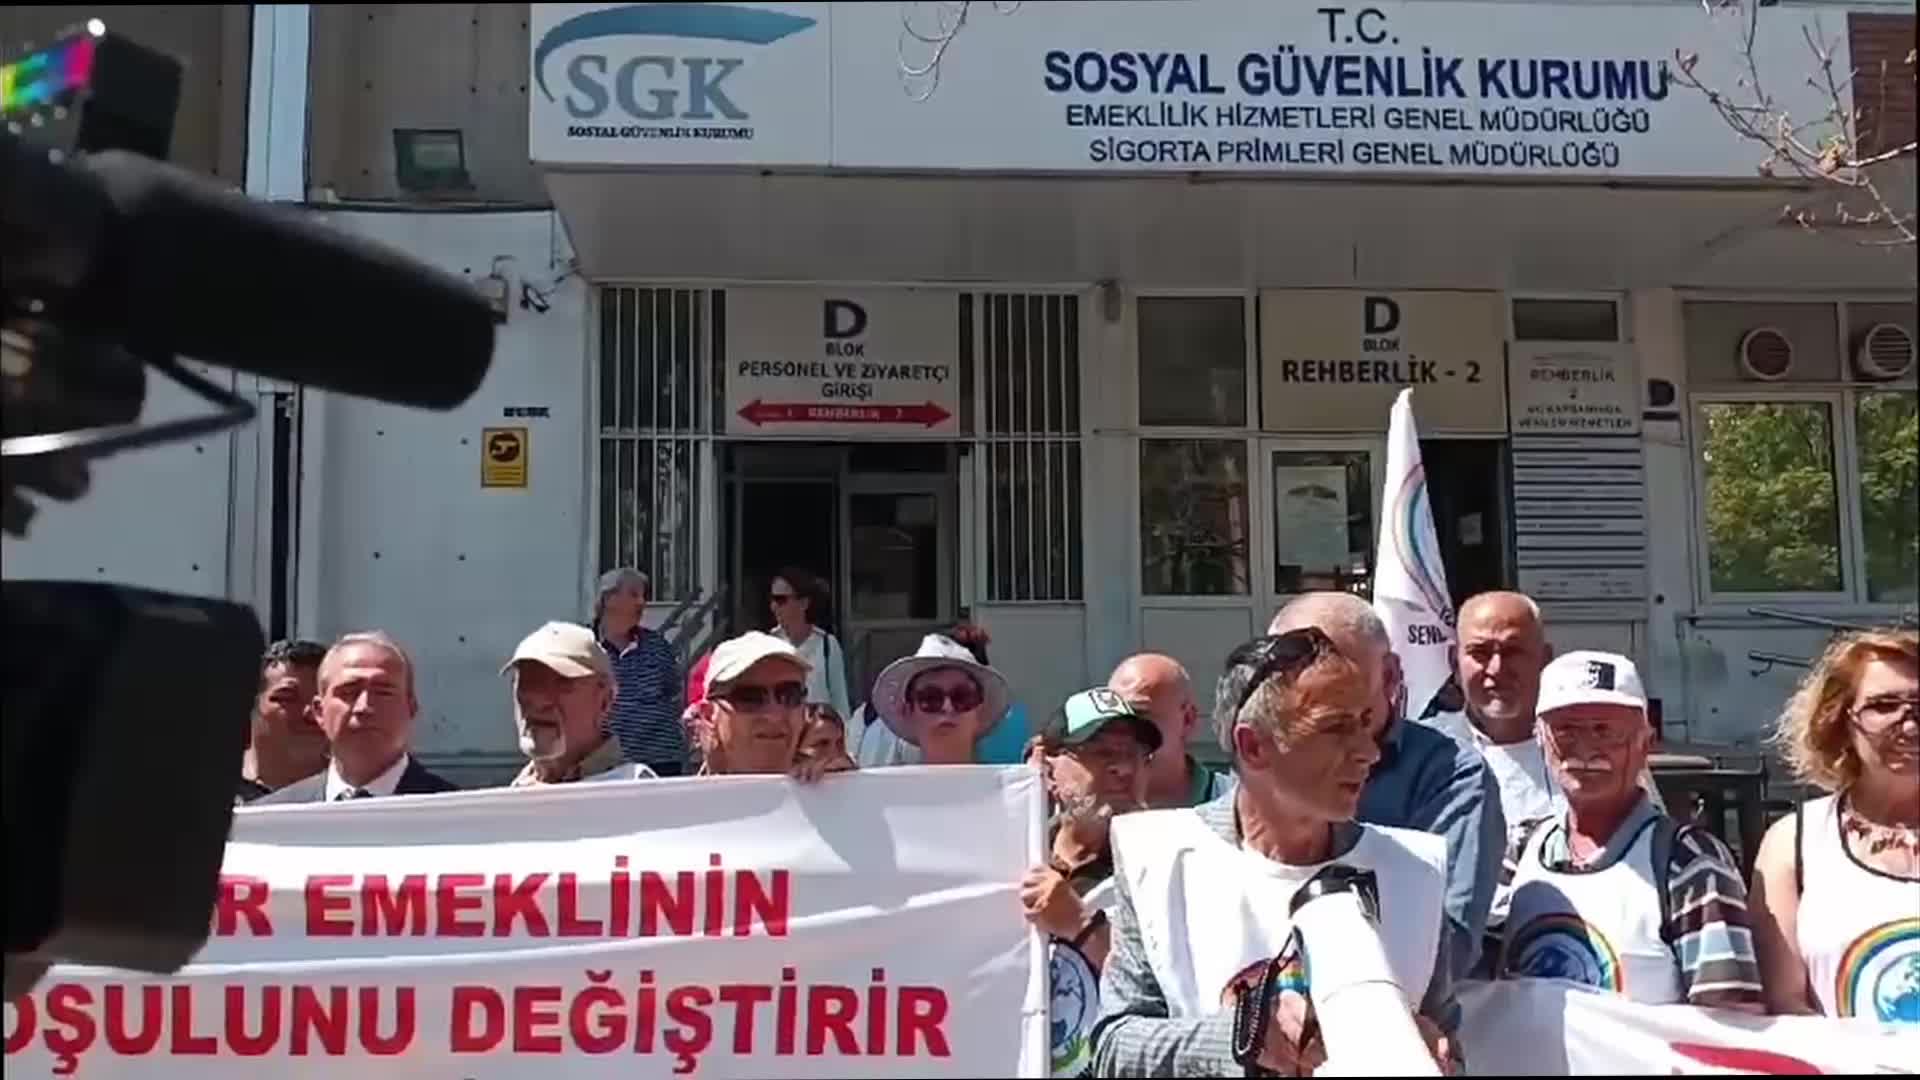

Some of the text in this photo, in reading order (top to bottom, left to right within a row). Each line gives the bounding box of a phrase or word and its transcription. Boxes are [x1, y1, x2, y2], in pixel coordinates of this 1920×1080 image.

[1317, 7, 1399, 45] T.C.
[564, 53, 750, 121] SGK
[1044, 46, 1668, 101] SOSYAL GÜVENLİK KURUMU
[1066, 101, 1651, 134] EMEKLİLİK HİZMETLERİ GENEL MÜDÜRLÜĞÜ
[1089, 136, 1620, 168] SİGORTA PRİMLERİ GENEL MÜDÜRLÜĞÜ
[823, 299, 868, 339] D
[1364, 296, 1401, 334] D
[825, 342, 865, 357] BLOK
[738, 360, 831, 379] PERSONEL
[834, 362, 857, 379] VE
[1281, 353, 1438, 385] REHBERLİK
[1466, 360, 1481, 384] 2
[304, 853, 790, 937] EMEKLİNİN
[450, 967, 951, 1075] DEĞİŞTİRİR
